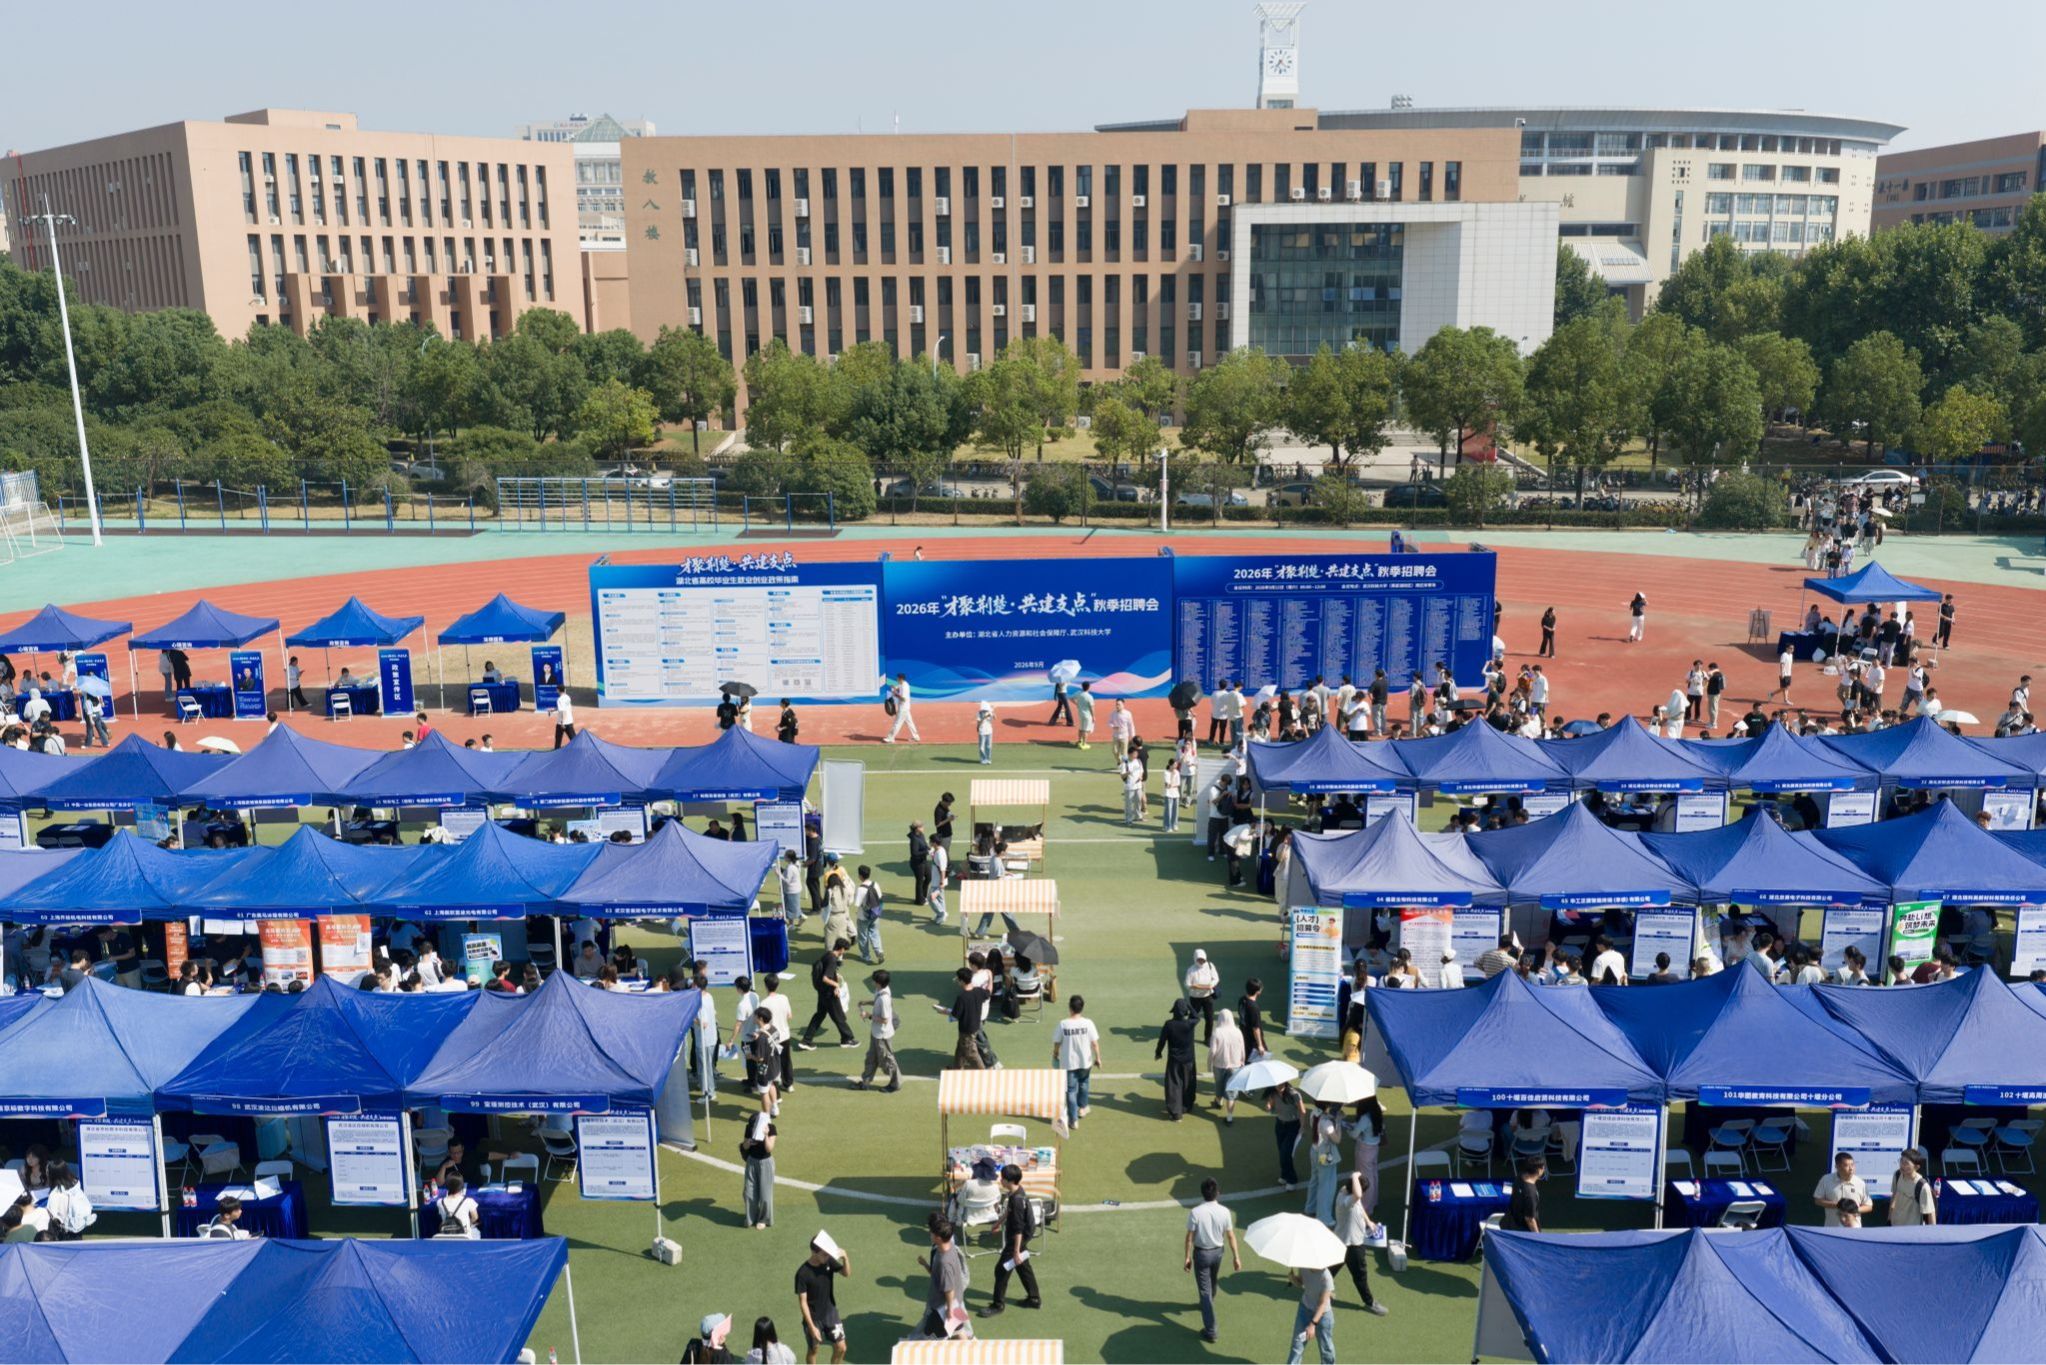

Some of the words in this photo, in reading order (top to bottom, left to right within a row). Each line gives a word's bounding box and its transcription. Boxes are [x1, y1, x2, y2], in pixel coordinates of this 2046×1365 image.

[676, 576, 799, 585] 湖北省高校毕业生就业创业政策指南
[1013, 660, 1045, 669] 2026年9月
[391, 663, 402, 701] 政策宣传区
[1561, 896, 1568, 904] 65
